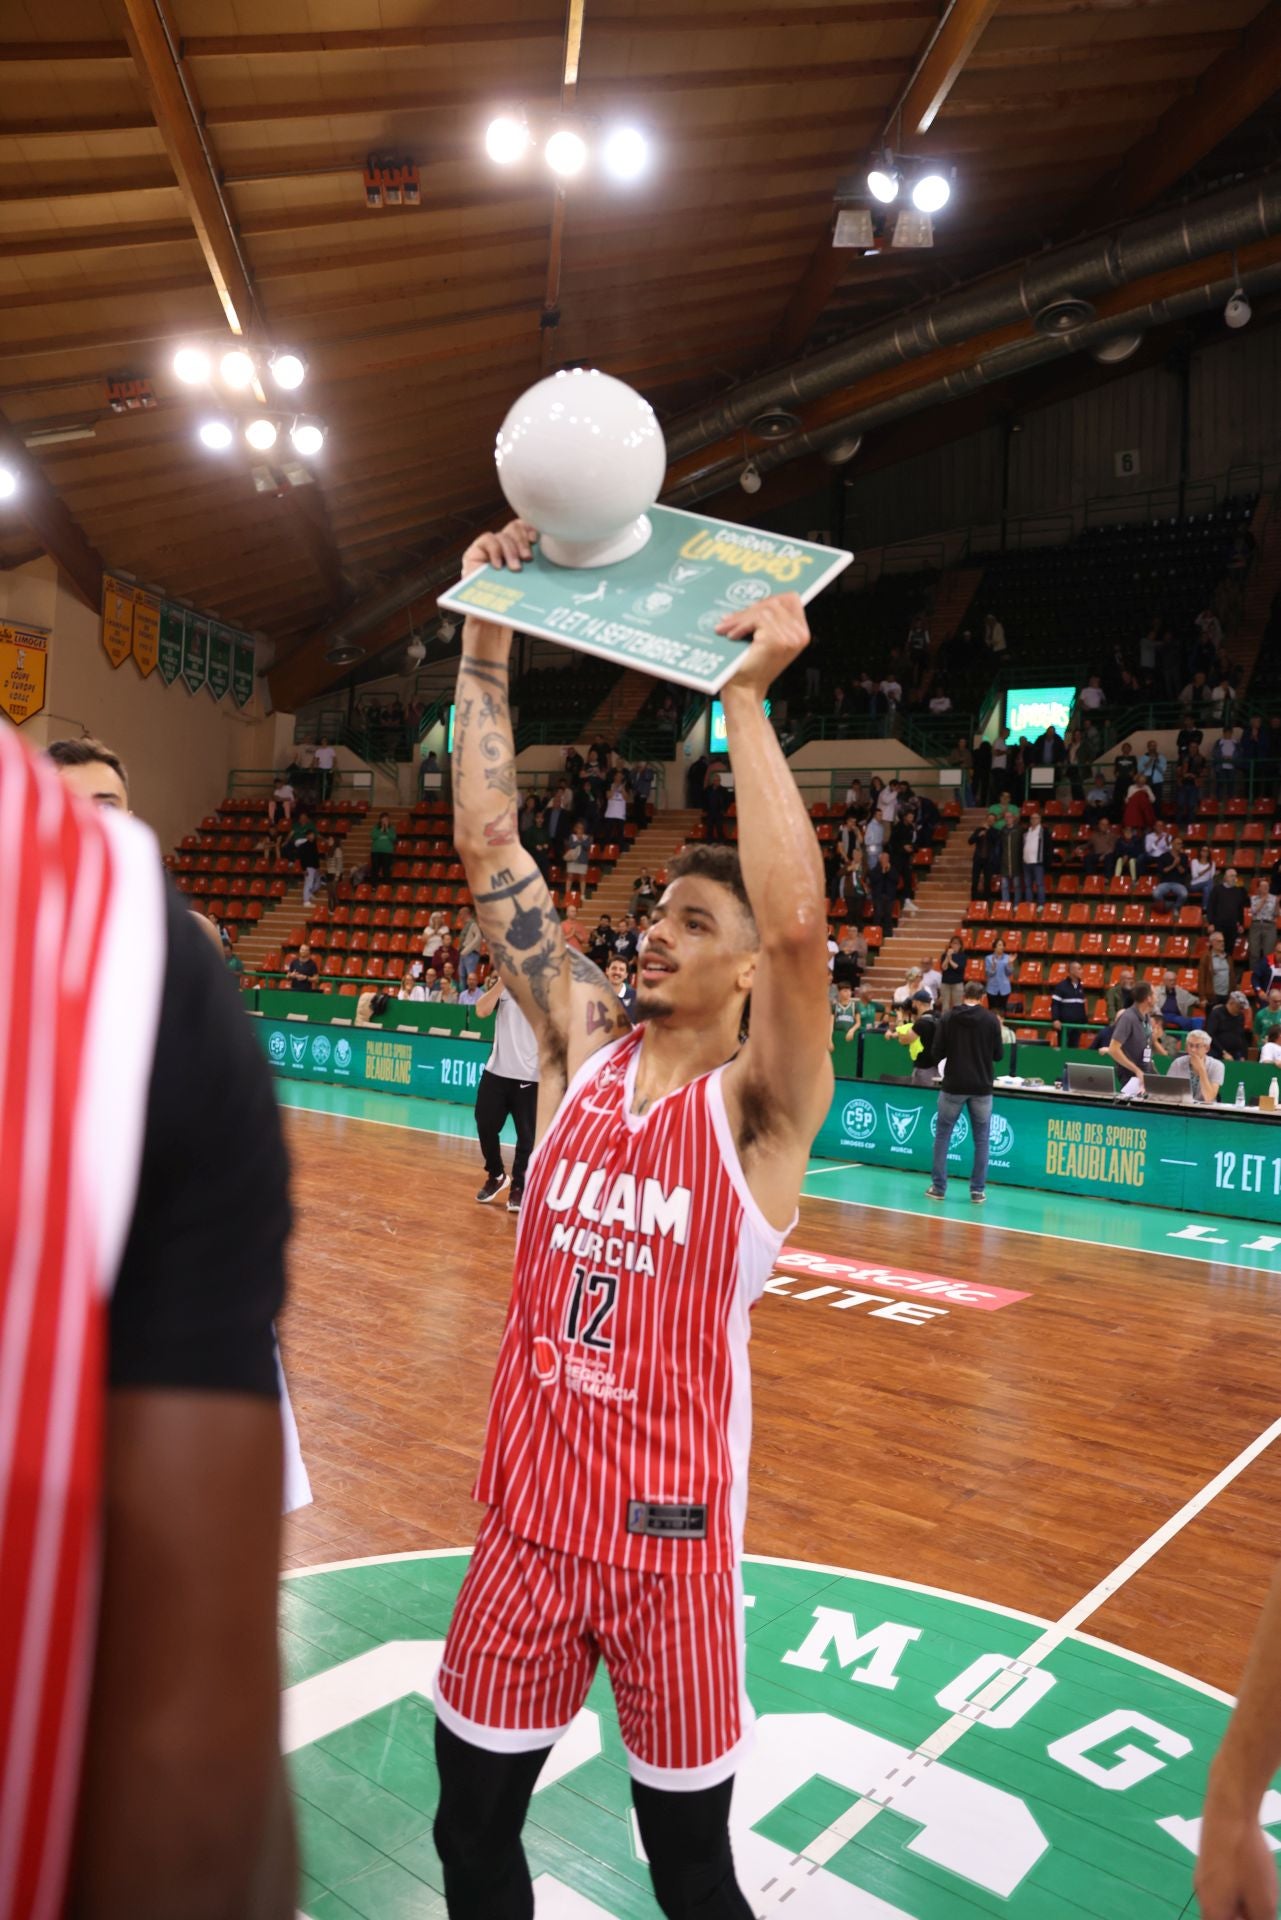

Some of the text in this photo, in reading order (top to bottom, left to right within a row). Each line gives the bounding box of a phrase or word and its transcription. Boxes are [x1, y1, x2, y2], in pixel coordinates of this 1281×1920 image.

[1121, 453, 1134, 473] 6
[14, 634, 47, 649] LIMOGES
[441, 1058, 451, 1084] 12
[452, 1059, 464, 1086] ET
[466, 1061, 477, 1087] 14
[847, 1108, 873, 1128] CSP
[1047, 1118, 1147, 1150] PALAIS DES SPORTS
[1046, 1140, 1145, 1187] BEAUBLANC
[1214, 1151, 1281, 1195] 12 ET 1
[545, 1158, 692, 1246] UCAM
[551, 1222, 656, 1278] MURCIA
[763, 1270, 950, 1326] LITE
[776, 1252, 997, 1302] Betclic
[563, 1264, 618, 1351] 12
